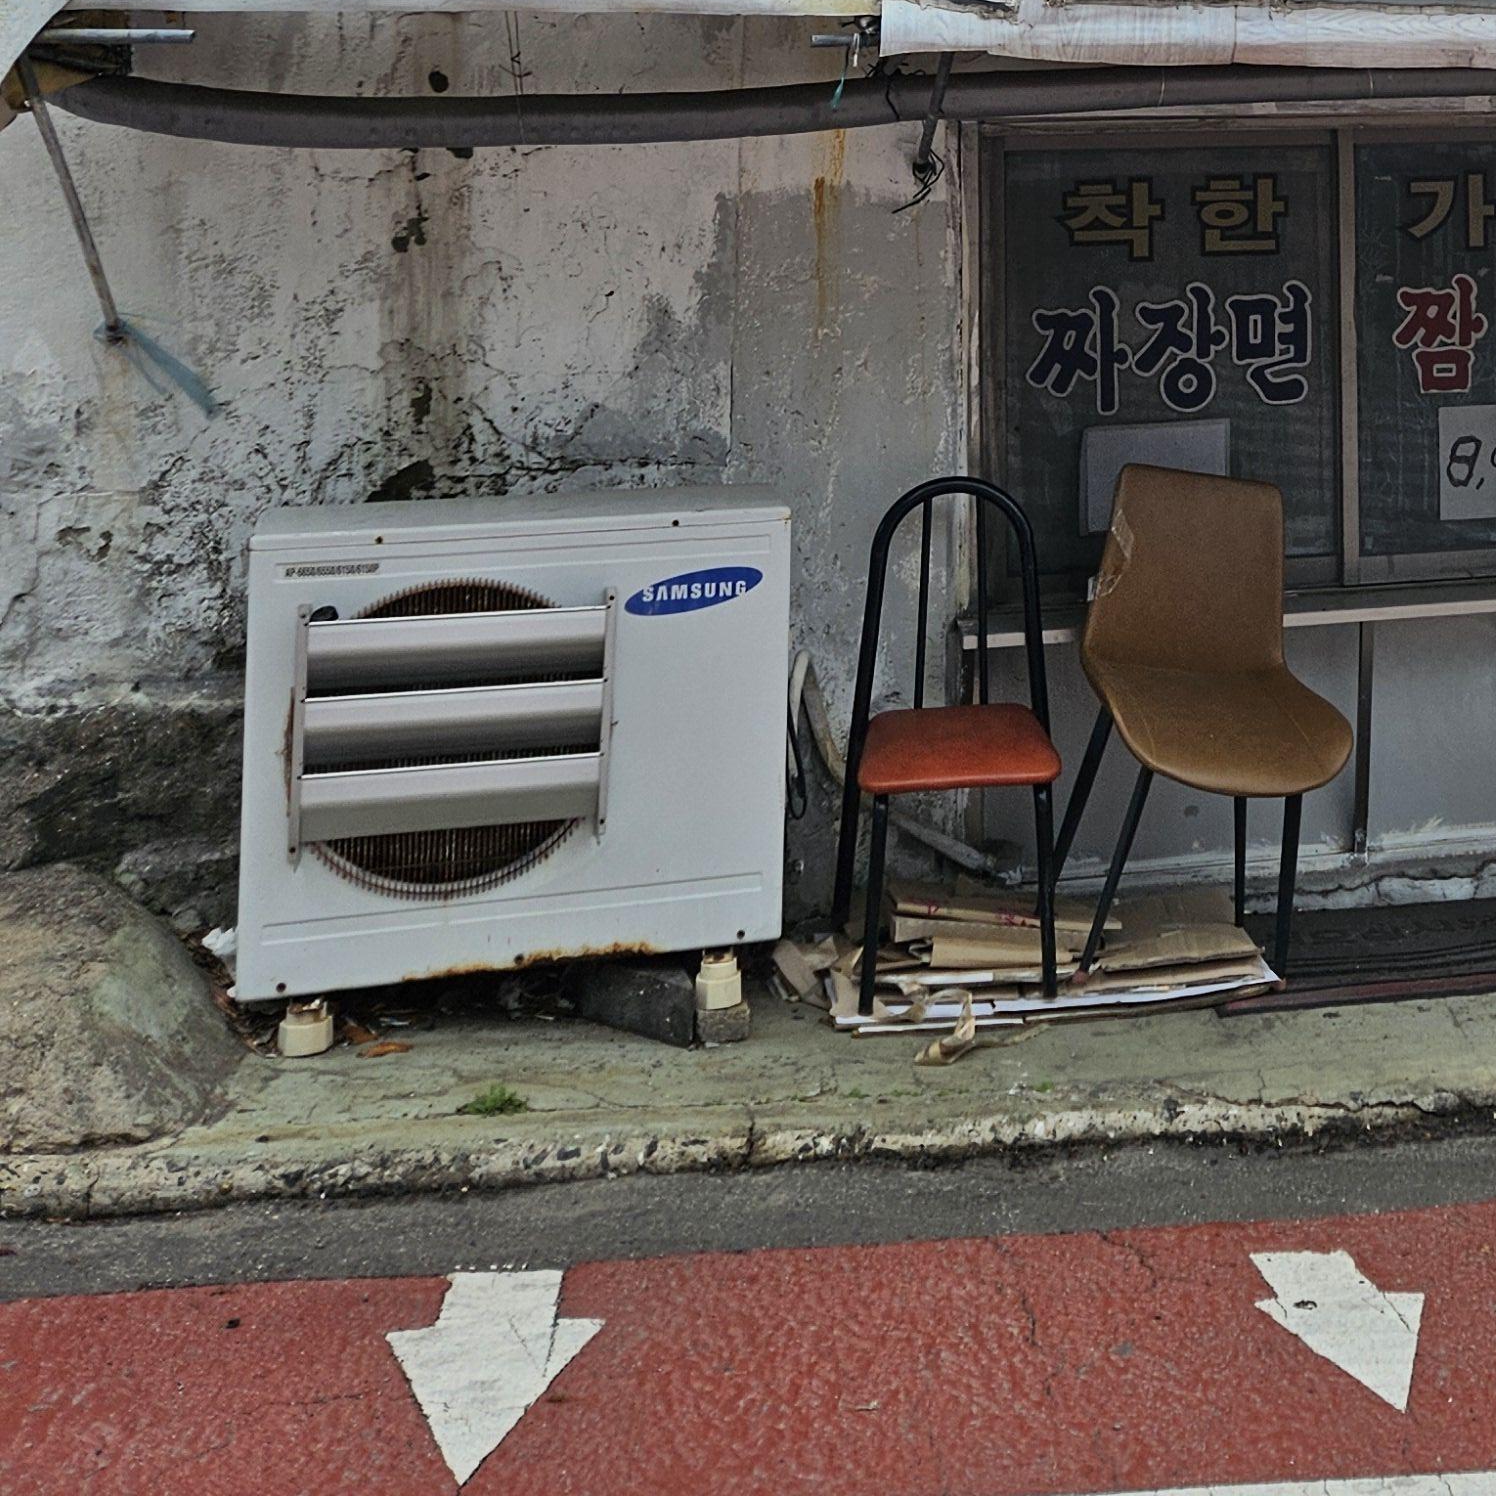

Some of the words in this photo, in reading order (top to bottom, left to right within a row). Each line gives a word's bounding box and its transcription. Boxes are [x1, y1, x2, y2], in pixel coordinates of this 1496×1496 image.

[1061, 172, 1288, 261] 착한
[1026, 278, 1314, 417] 짜장면
[641, 579, 747, 603] SAMSUNG
